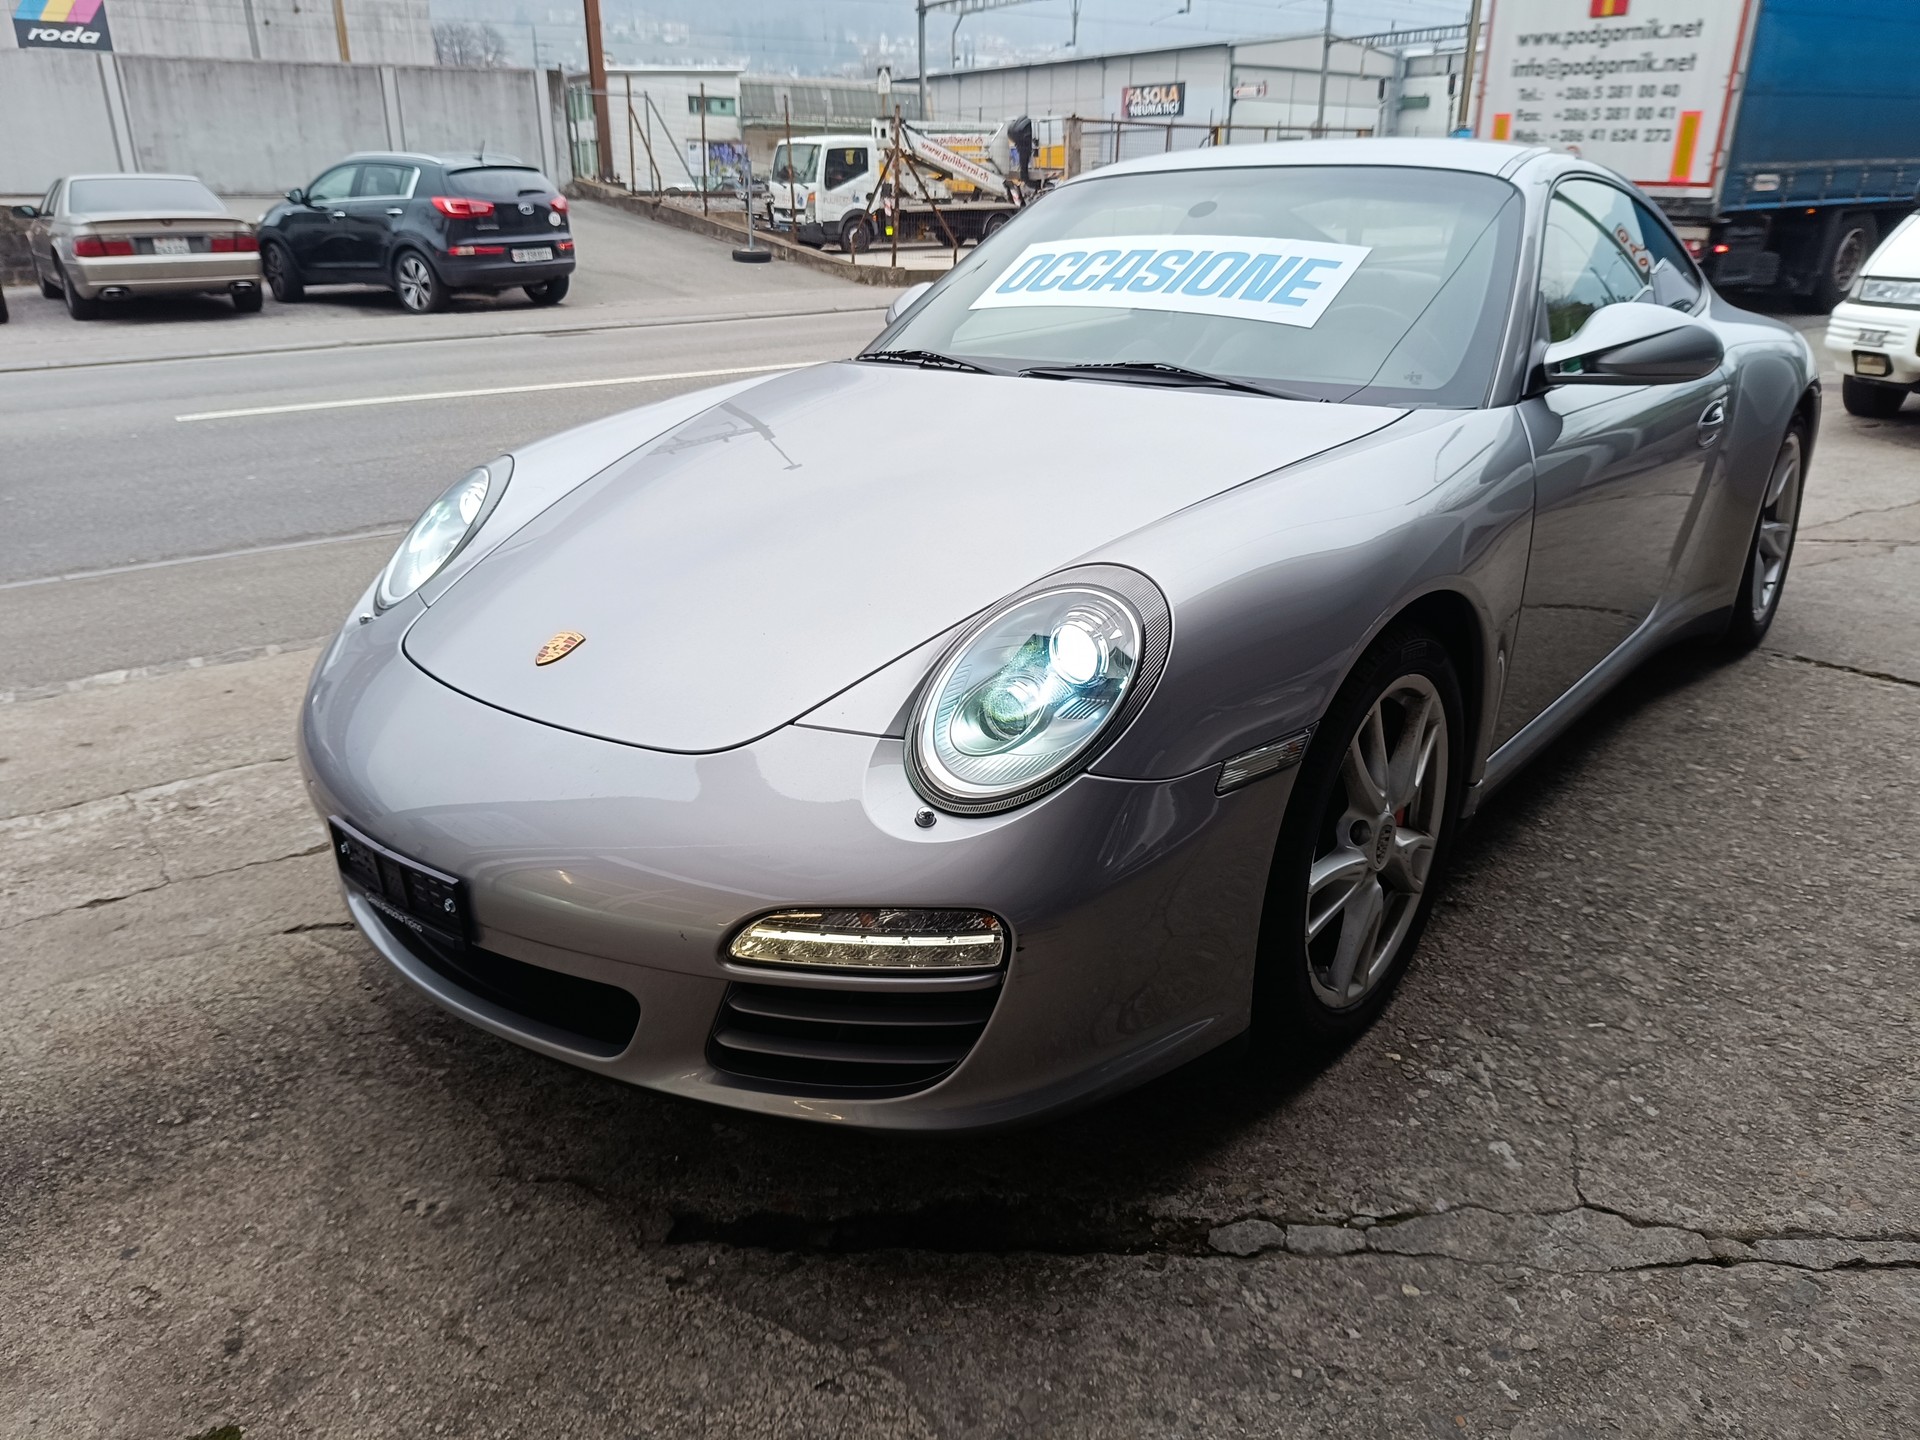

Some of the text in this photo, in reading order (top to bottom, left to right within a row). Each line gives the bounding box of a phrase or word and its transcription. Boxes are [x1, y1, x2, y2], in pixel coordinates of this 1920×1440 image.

[27, 26, 101, 44] roda
[1517, 18, 1703, 48] www.podgornik.net
[1511, 52, 1697, 80] info@podgornik.net
[1125, 85, 1179, 106] FASOLA
[921, 142, 988, 182] www.puliberni.ch
[996, 249, 1343, 307] OCCASIONE
